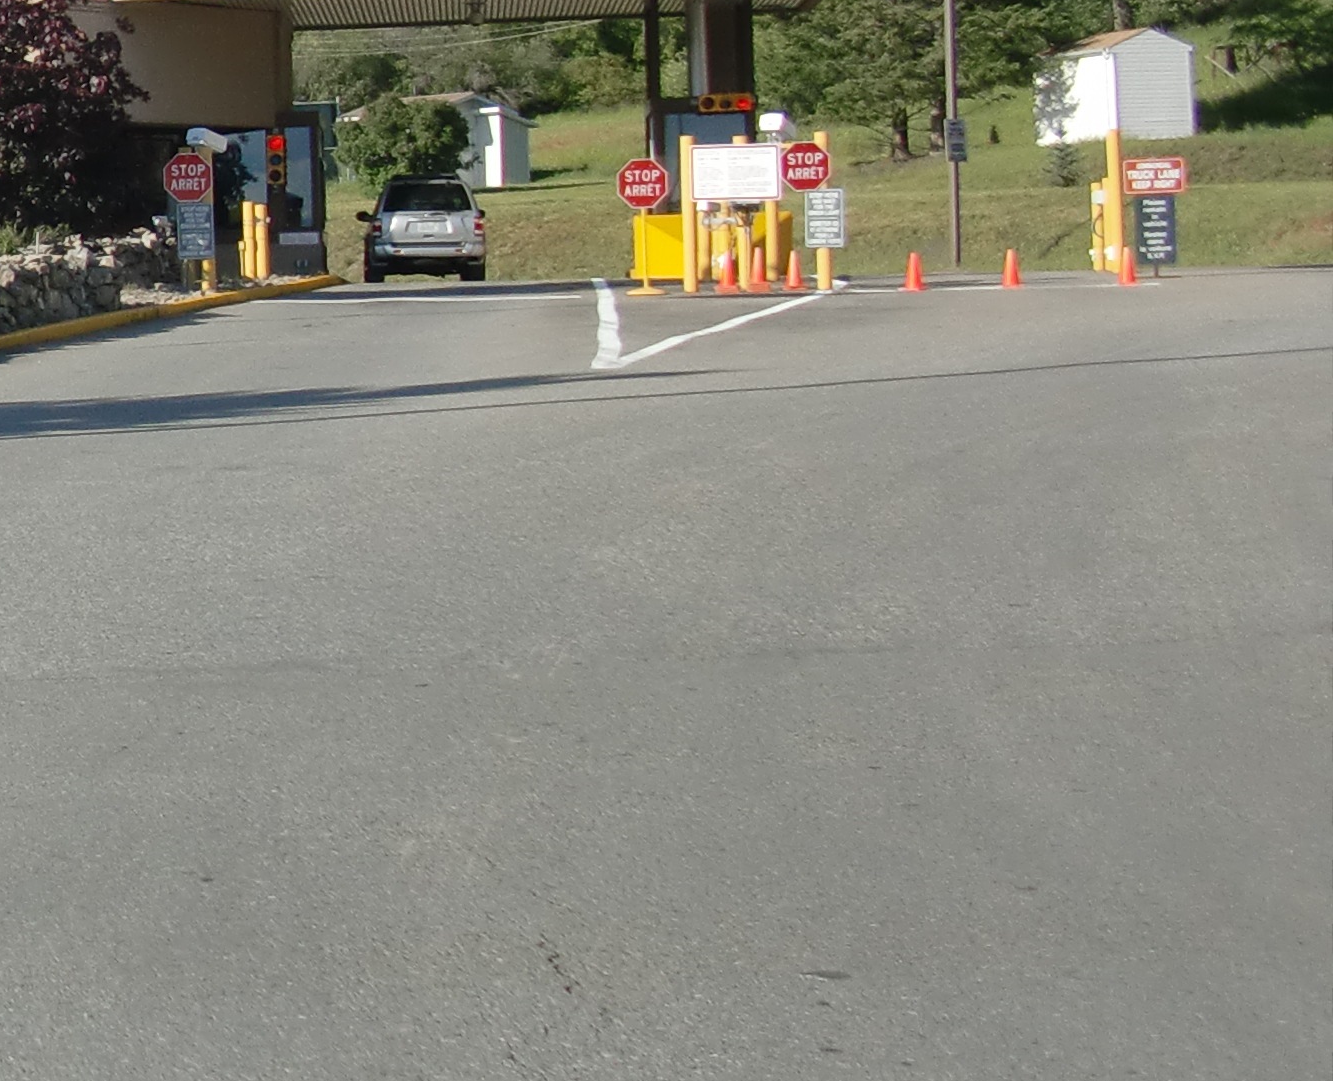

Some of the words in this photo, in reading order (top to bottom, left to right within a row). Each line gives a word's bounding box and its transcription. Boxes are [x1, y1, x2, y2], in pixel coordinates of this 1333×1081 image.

[786, 152, 824, 166] STOP
[170, 163, 206, 177] STOP
[624, 169, 661, 183] STOP
[786, 166, 825, 180] ARRÊT
[623, 182, 662, 197] ARRÊT
